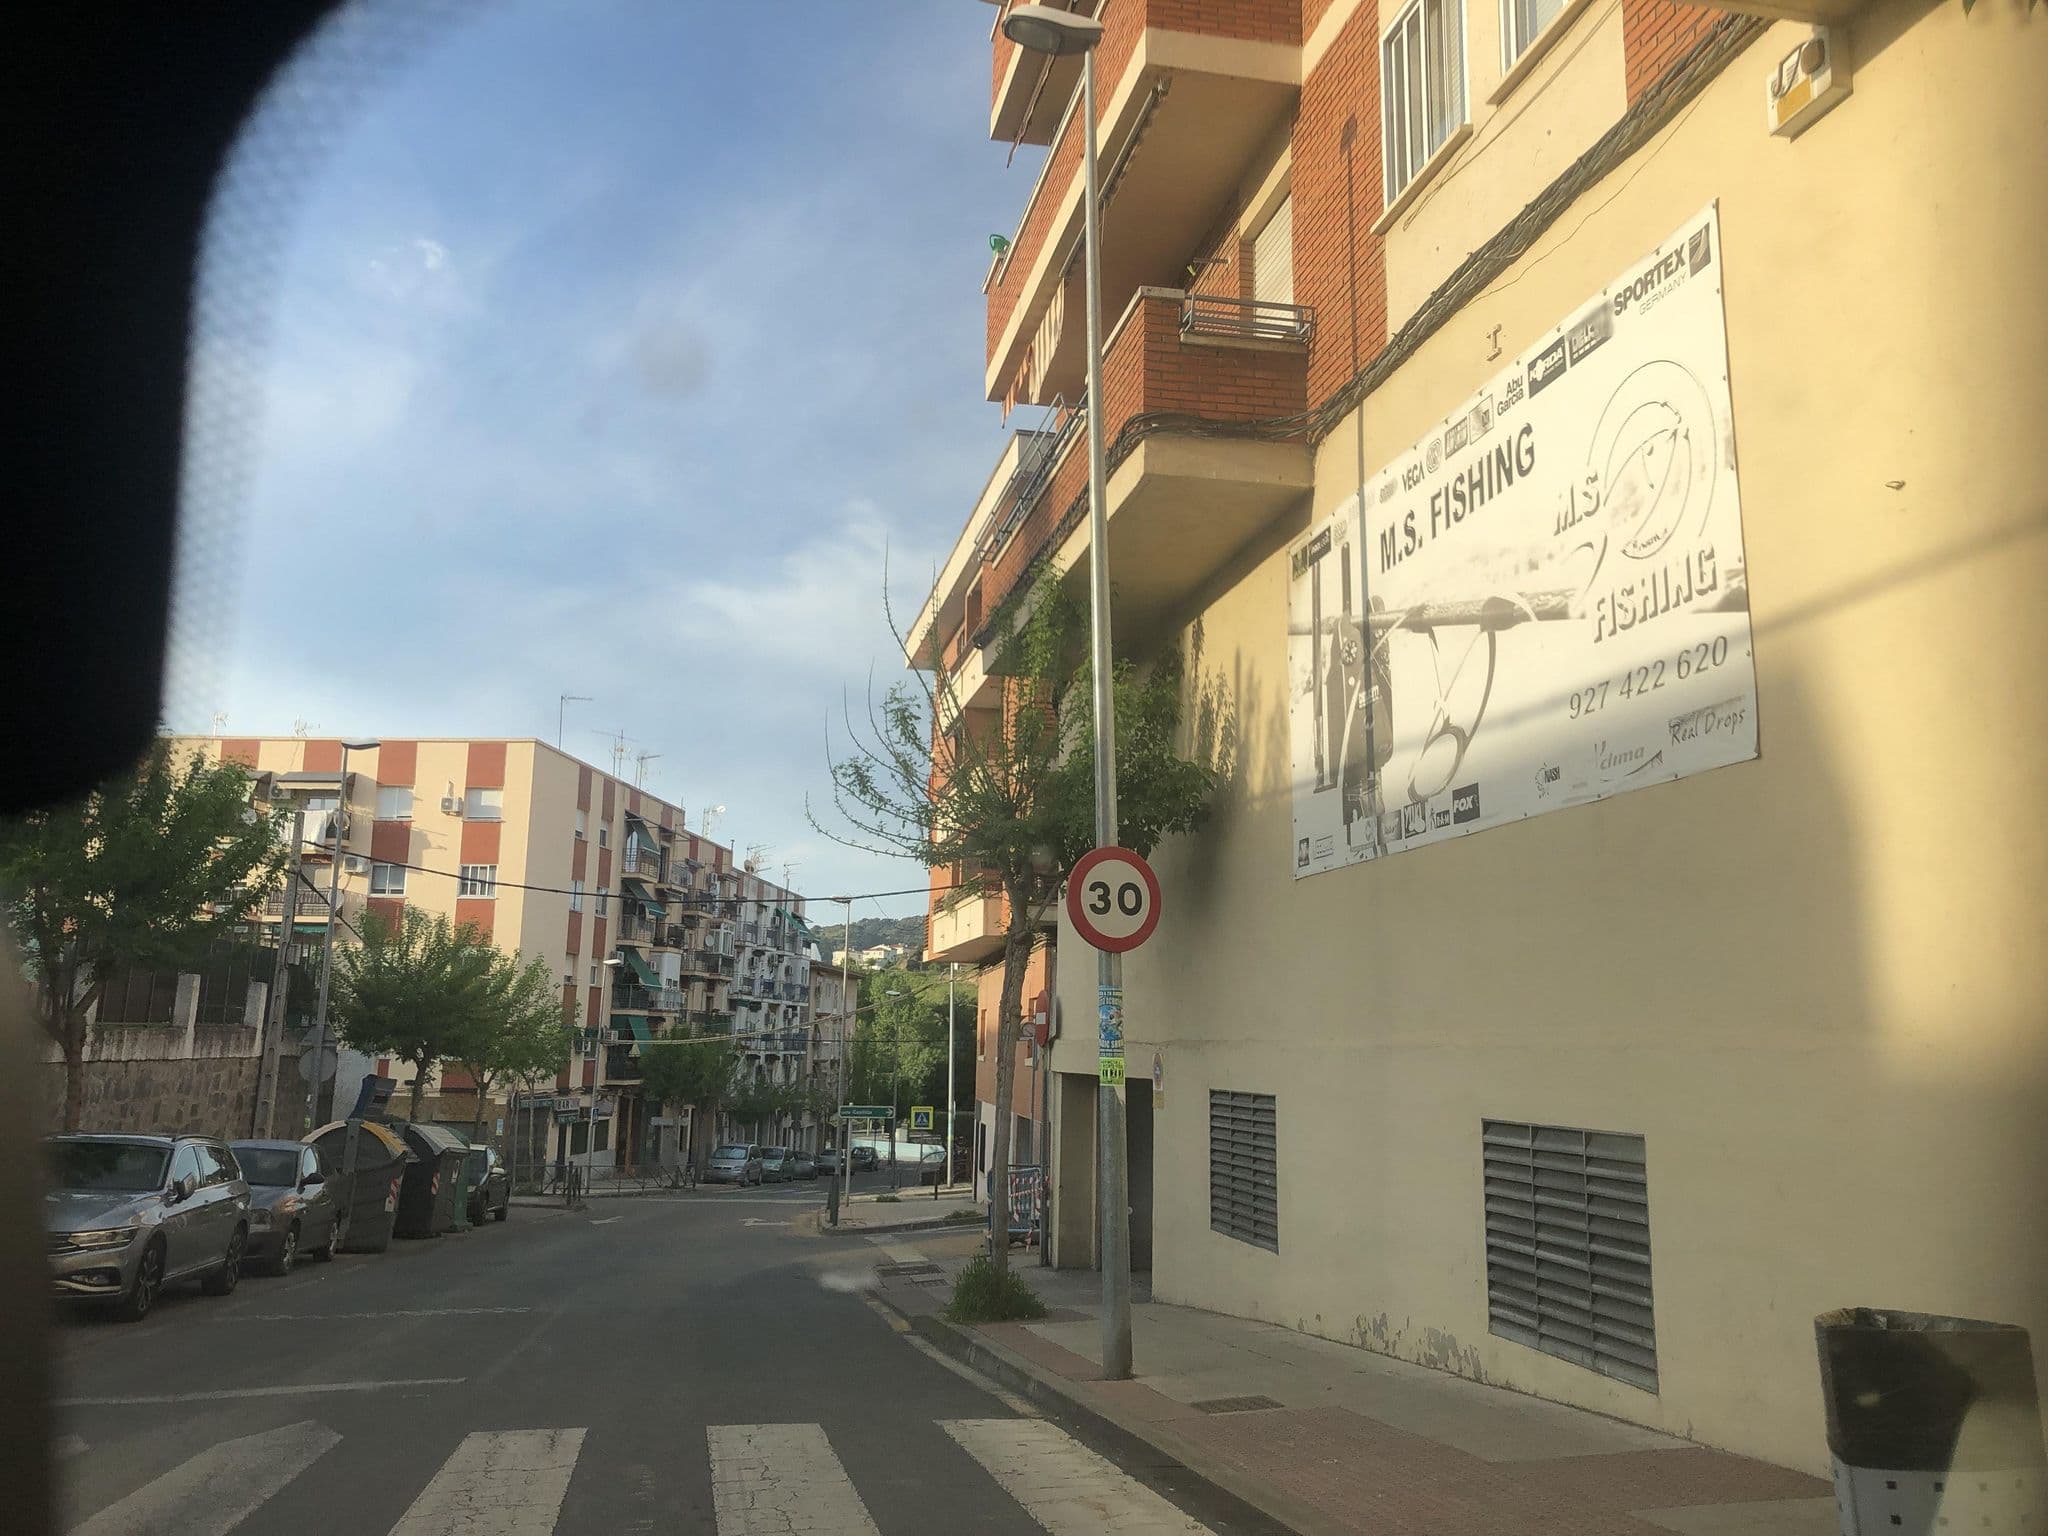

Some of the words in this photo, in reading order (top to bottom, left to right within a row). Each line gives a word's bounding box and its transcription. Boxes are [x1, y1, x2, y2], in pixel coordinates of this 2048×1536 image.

[1613, 242, 1686, 316] SPORTEX
[1639, 271, 1687, 316] GERMANY
[1506, 375, 1523, 398] Abu
[1401, 461, 1425, 492] VEGA
[1380, 509, 1423, 574] M.S.
[1430, 422, 1535, 540] FISHING
[1569, 680, 1610, 720] 927
[1618, 660, 1666, 699] 422
[1676, 635, 1728, 680] 620
[1704, 708, 1746, 736] Drops
[1454, 795, 1474, 814] FOX
[1088, 881, 1143, 917] 30
[556, 1100, 570, 1110] BAR
